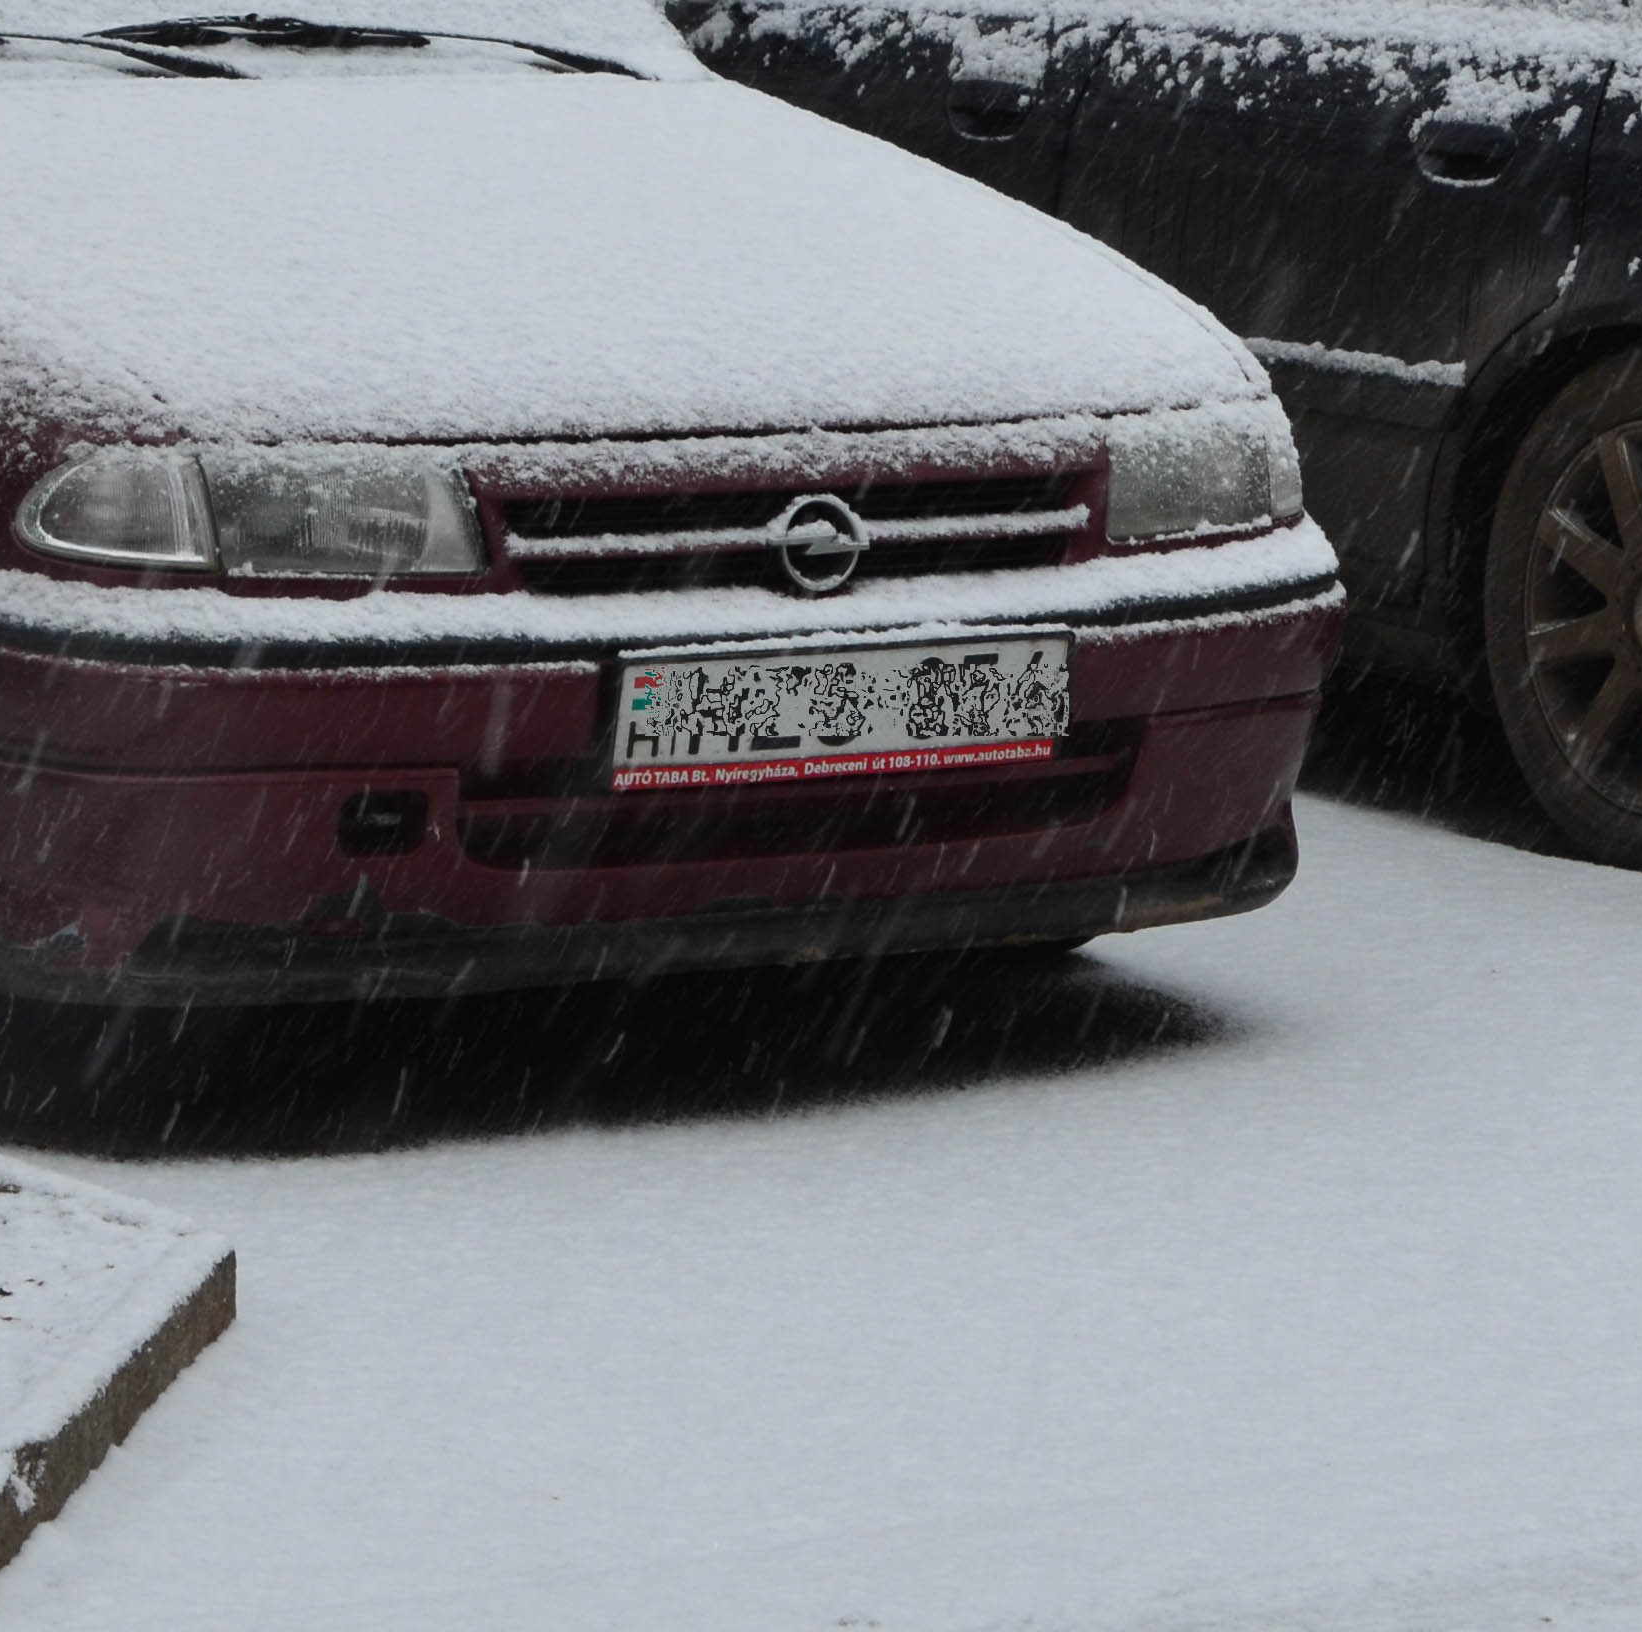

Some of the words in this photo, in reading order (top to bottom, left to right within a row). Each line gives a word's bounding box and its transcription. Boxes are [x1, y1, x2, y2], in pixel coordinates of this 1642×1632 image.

[614, 769, 652, 787] AUTÓ
[654, 770, 689, 785] TABA
[691, 769, 709, 784] Bt.
[715, 764, 798, 784] Nyíregyháza,
[804, 759, 867, 776] Debreceni
[872, 756, 885, 770] út
[888, 754, 941, 769] 108-110.
[943, 744, 1051, 765] www.autotaba.hu
